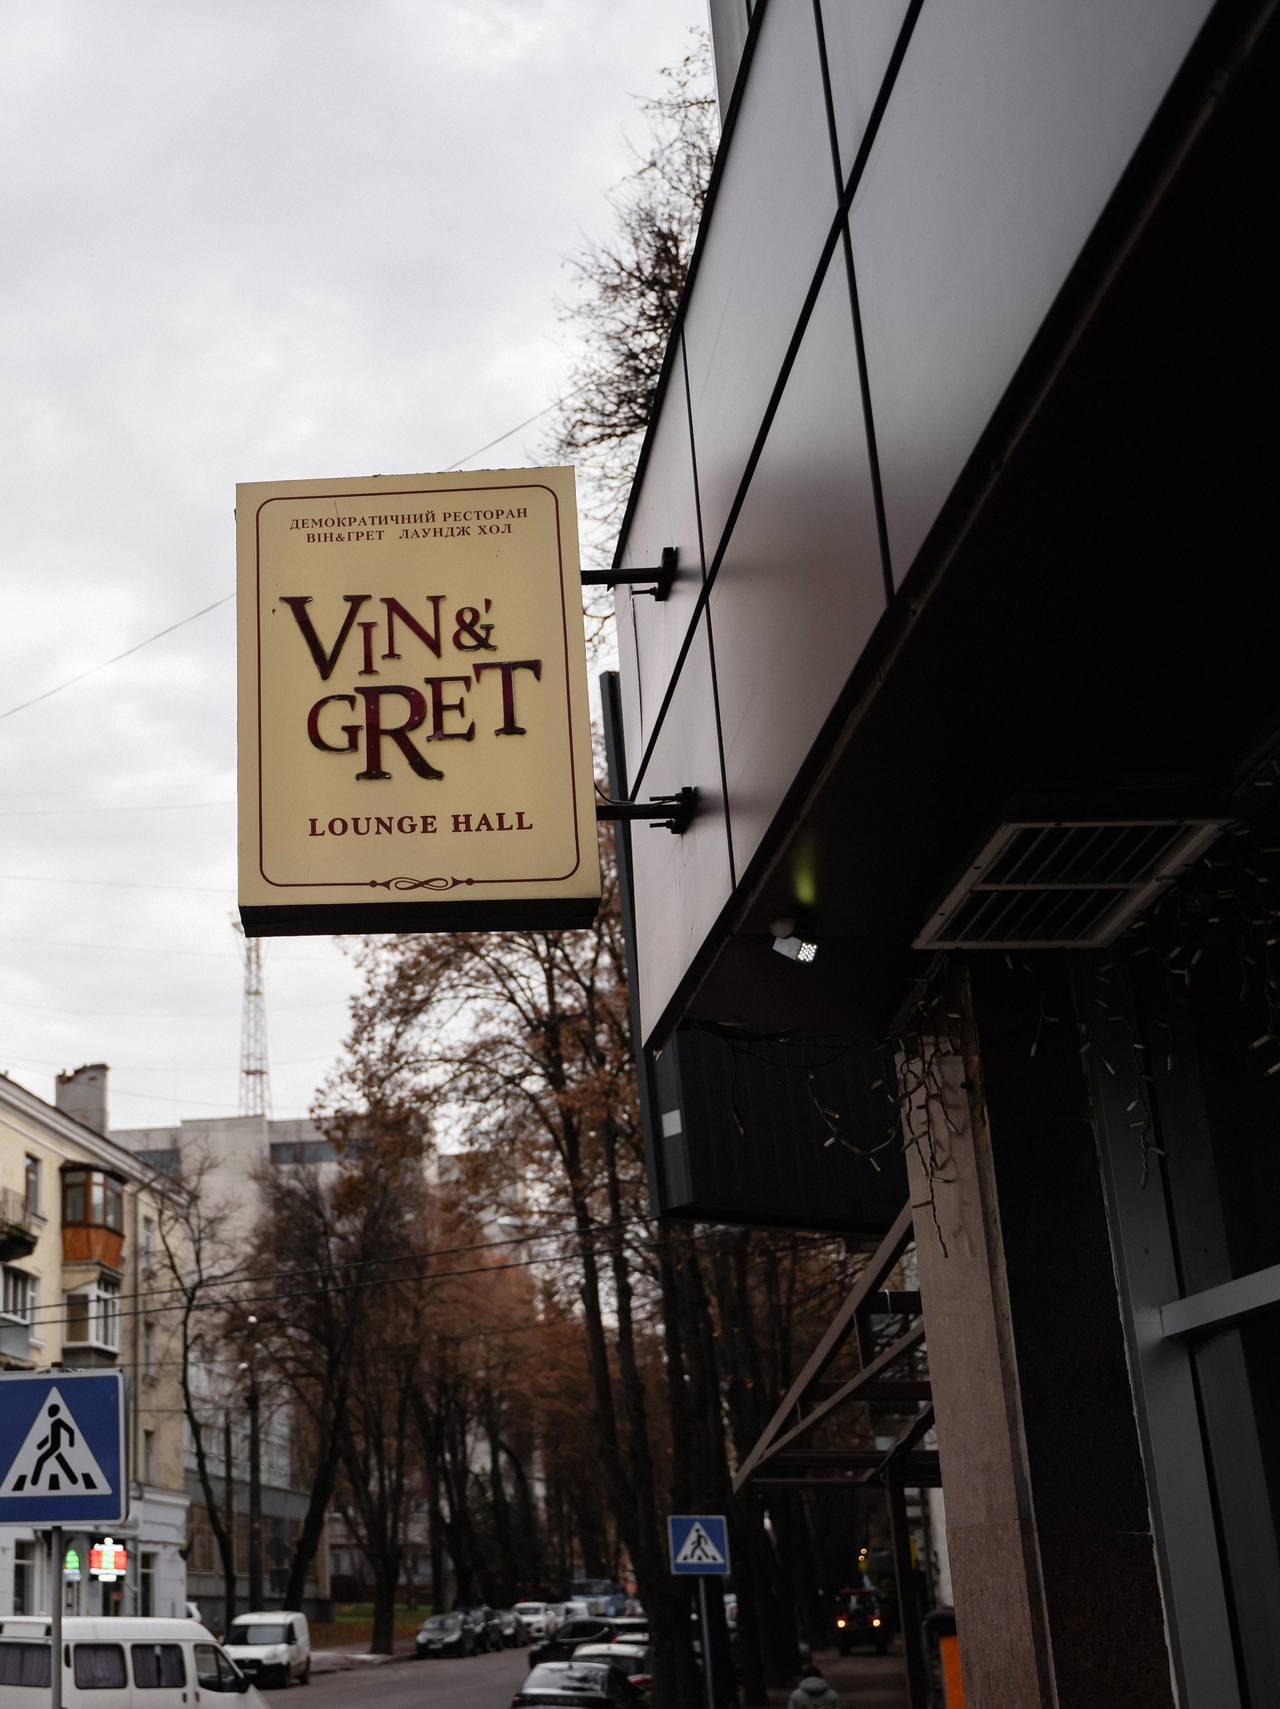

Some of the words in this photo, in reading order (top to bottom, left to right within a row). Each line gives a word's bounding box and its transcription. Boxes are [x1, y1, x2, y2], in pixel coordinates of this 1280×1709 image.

[289, 510, 436, 530] ДЕМОКРАТИЧНИЙ
[442, 507, 528, 523] РЕСТОРАН
[306, 530, 385, 543] ВІН&ГРЕТ
[398, 525, 471, 540] ЛАУНДЖ
[477, 523, 513, 536] ХОЛ
[306, 659, 543, 782] GRET
[308, 814, 438, 837] LOUNGE
[451, 811, 534, 833] HALL
